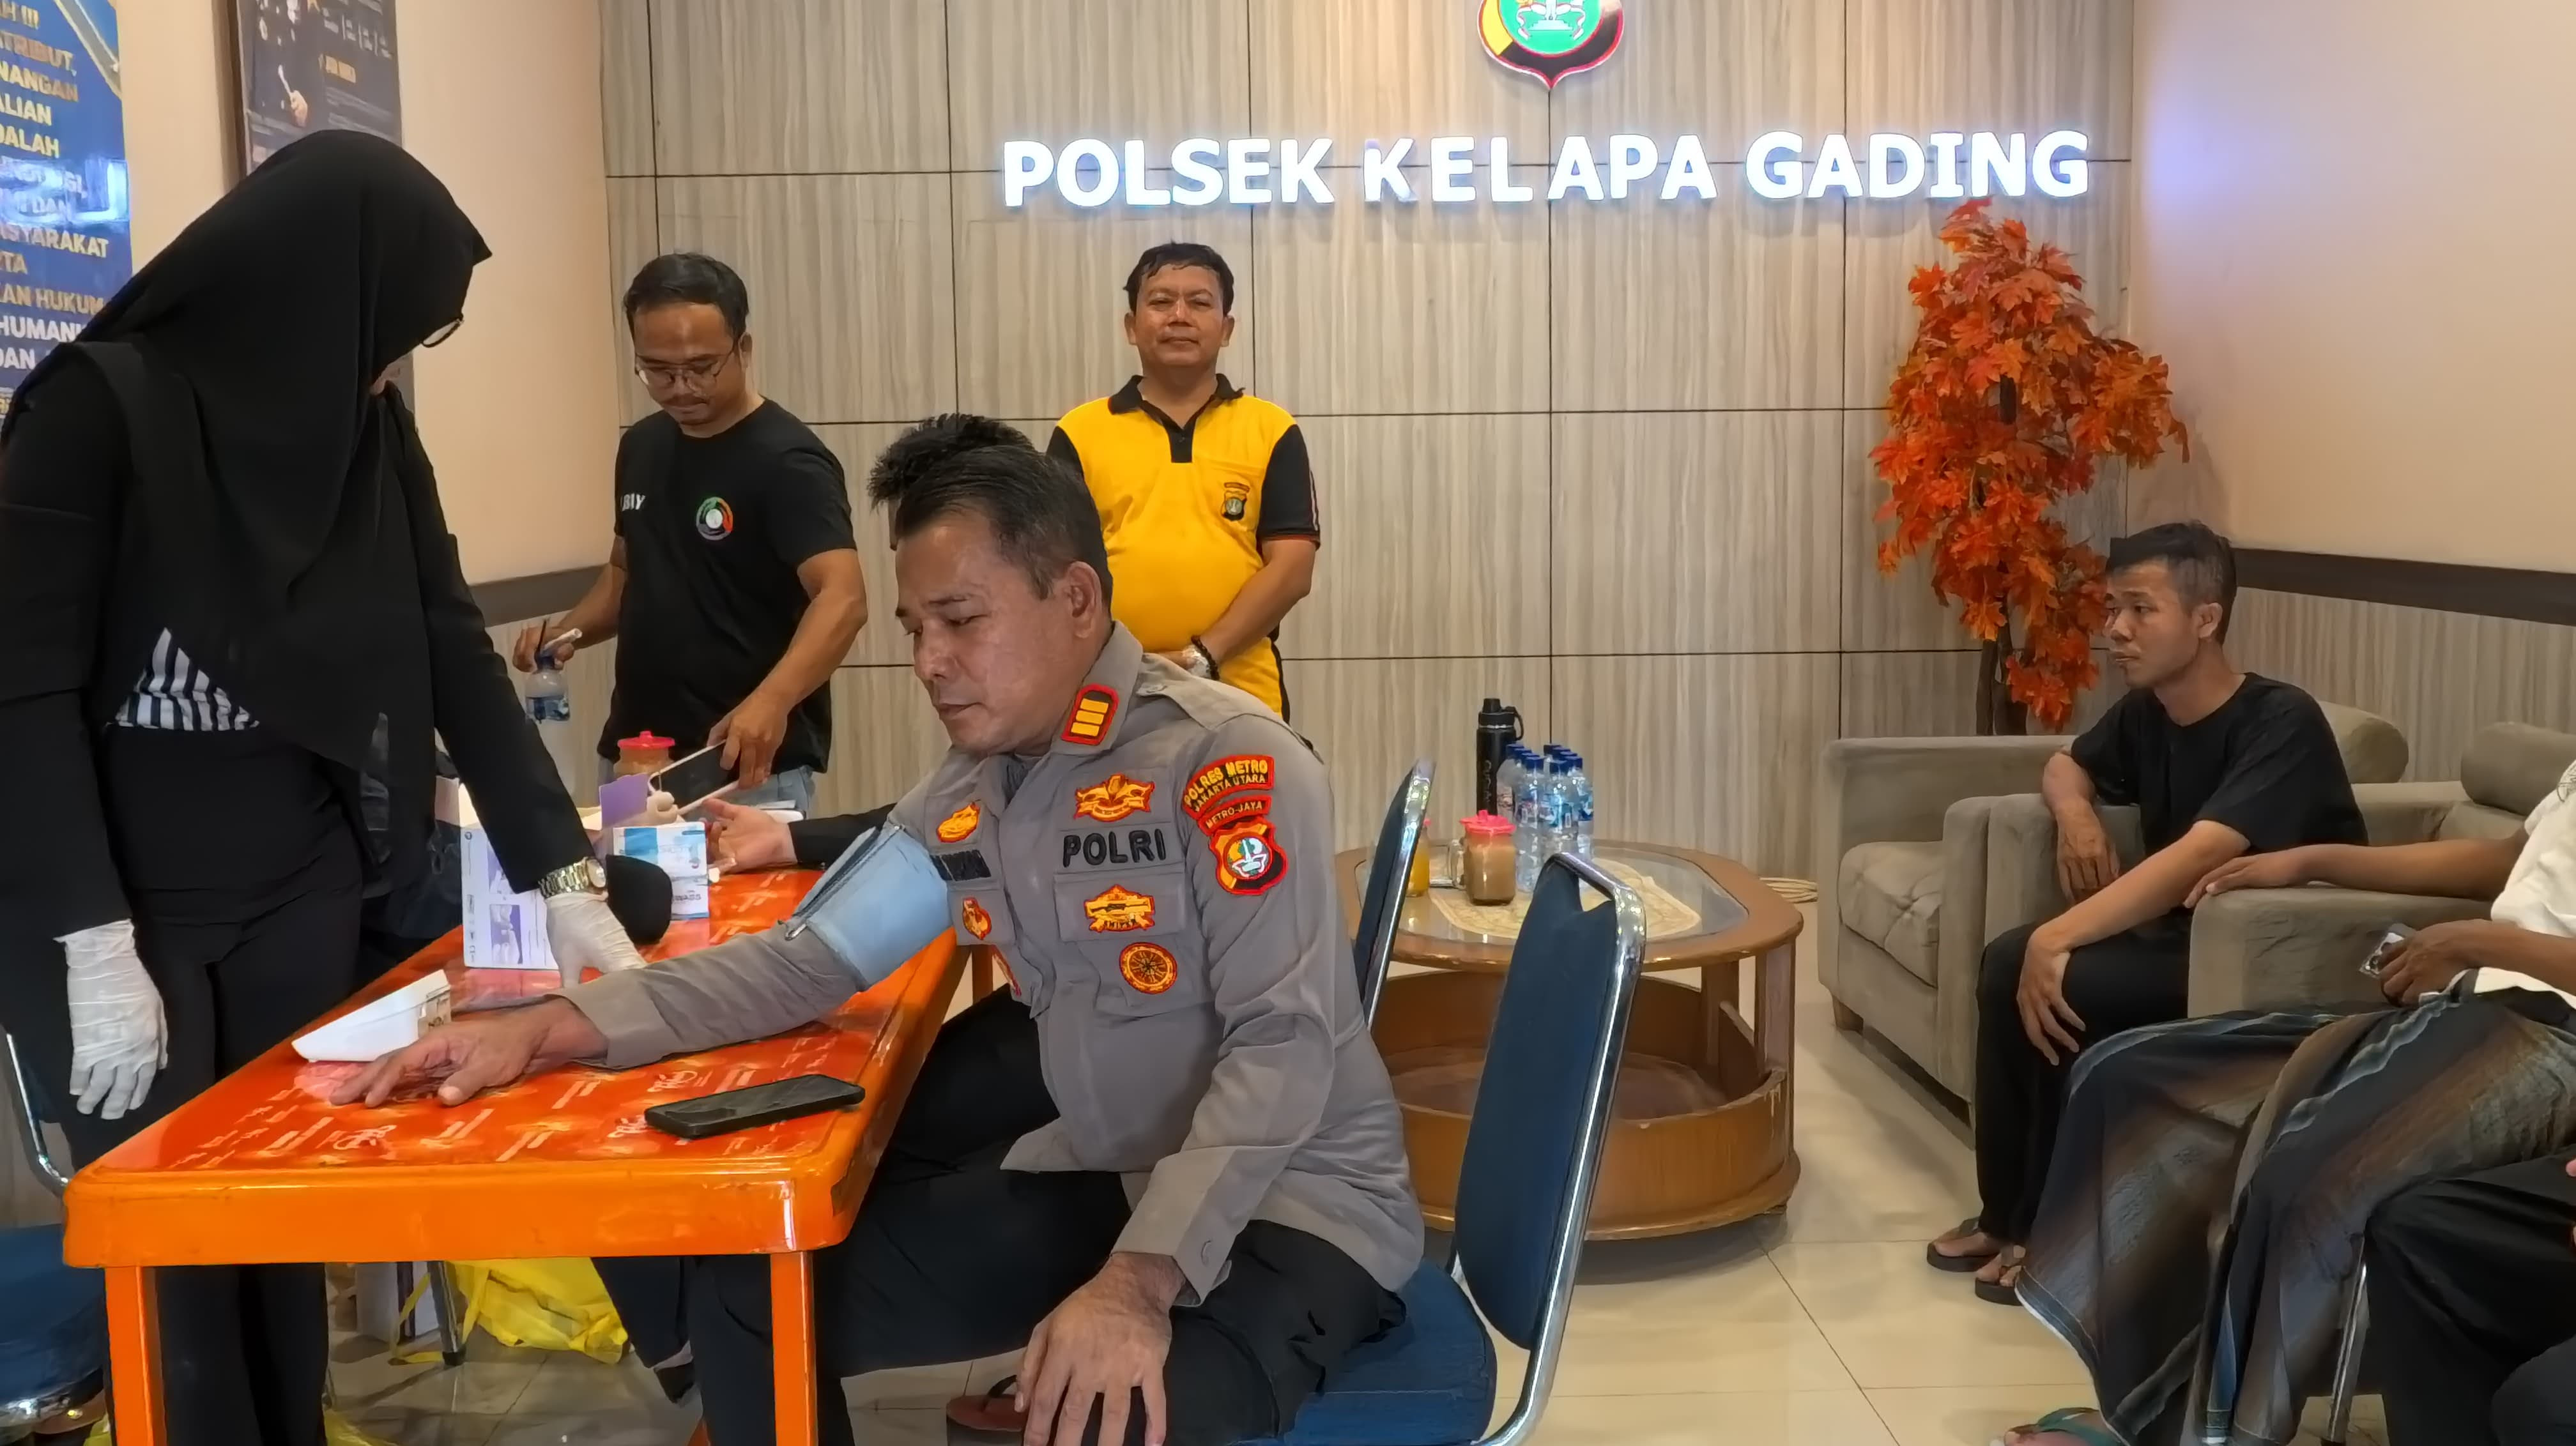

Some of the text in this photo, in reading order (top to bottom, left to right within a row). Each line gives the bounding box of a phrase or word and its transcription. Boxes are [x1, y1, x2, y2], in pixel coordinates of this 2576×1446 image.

[0, 31, 77, 76] TRIBUT,
[1003, 130, 2089, 207] POLSEK KELAPA GADING
[0, 222, 109, 258] SYARAKAT
[0, 283, 105, 314] AN HUKUM
[0, 314, 87, 342] HUMANI
[1184, 759, 1268, 807] POLRES METRO
[1233, 774, 1266, 786] UTARA
[1206, 800, 1262, 828] METRO-JAYA
[1062, 828, 1166, 867] POLRI
